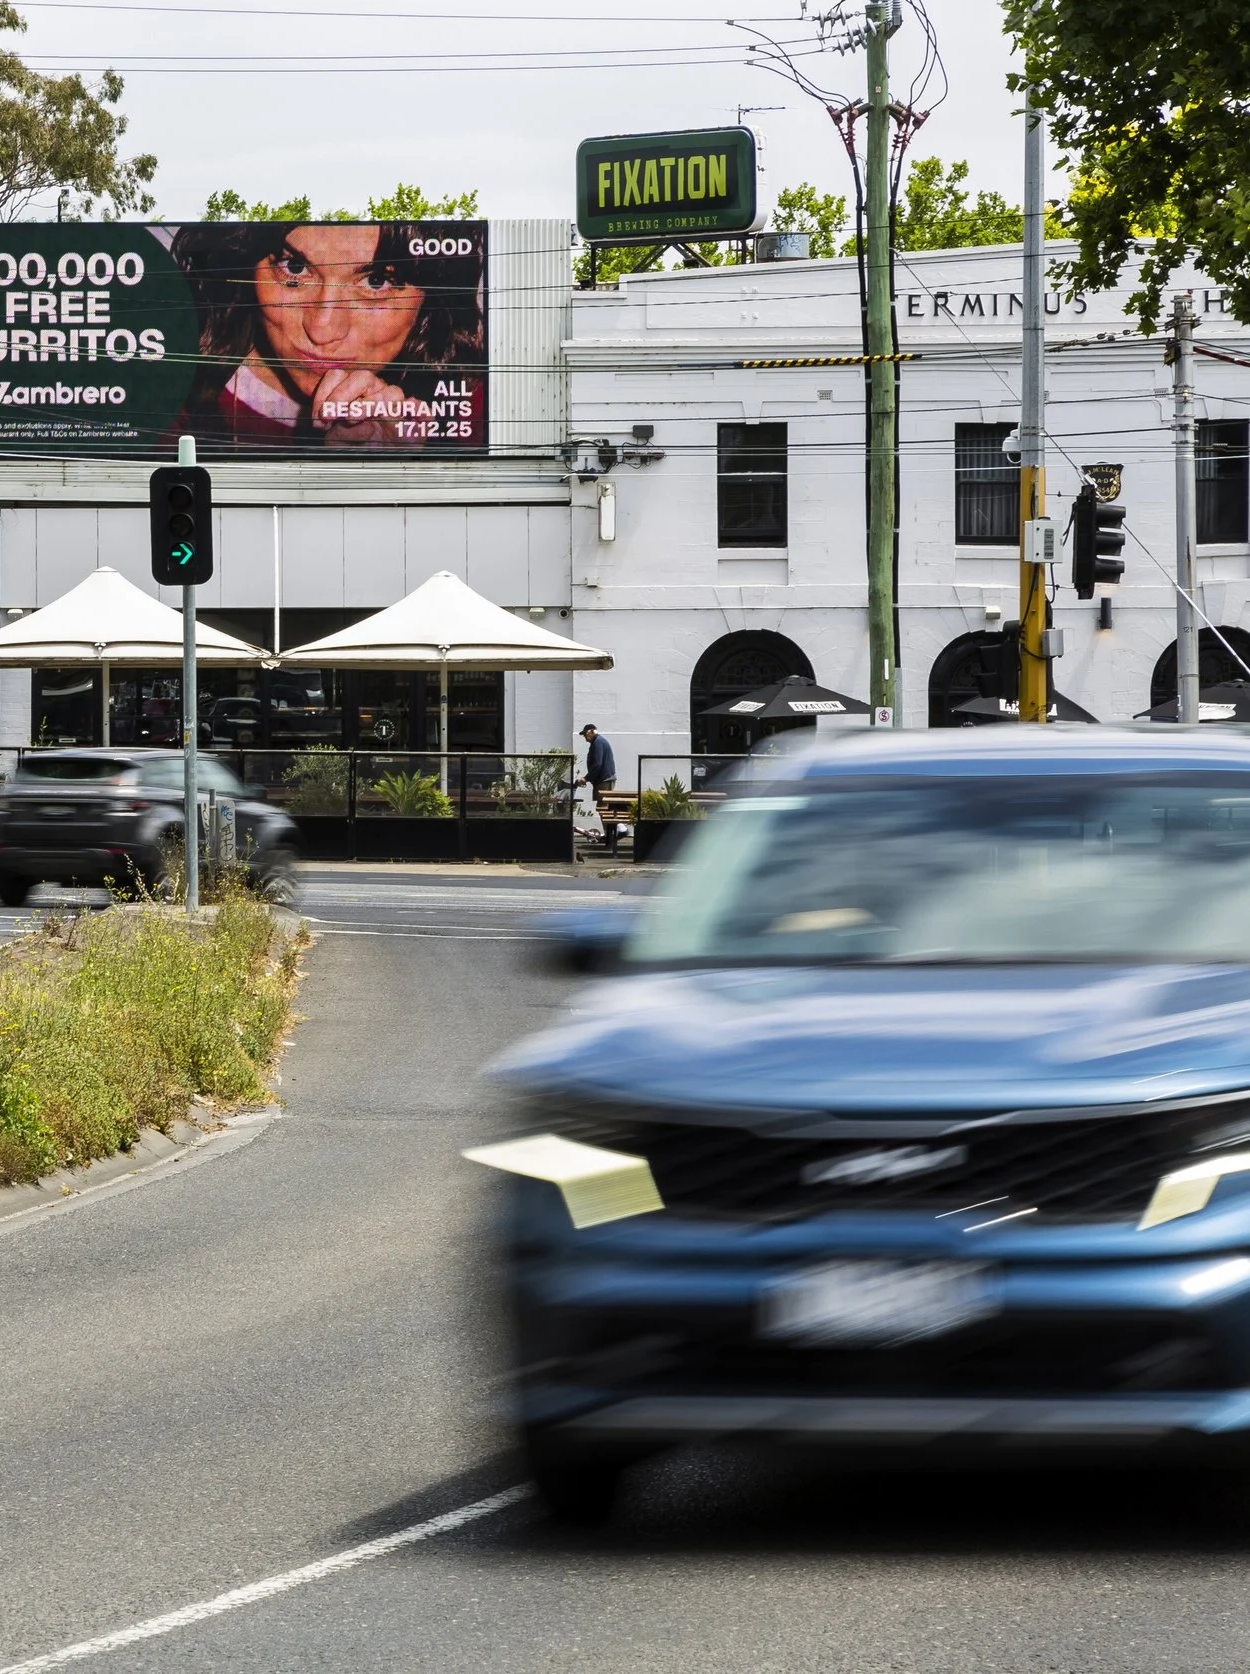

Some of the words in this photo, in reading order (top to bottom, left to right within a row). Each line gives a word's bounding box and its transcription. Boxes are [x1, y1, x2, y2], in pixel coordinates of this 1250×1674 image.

[598, 154, 727, 208] FIXATION
[608, 219, 659, 232] BREWING
[666, 216, 718, 228] COMPANY
[408, 238, 472, 255] GOOD
[5, 290, 111, 323] FREE
[894, 291, 1088, 317] ERMINUS
[433, 380, 473, 397] ALL
[322, 401, 473, 418] RESTAURANTS
[395, 421, 473, 438] 17.12.25
[793, 702, 840, 710] FIXATION
